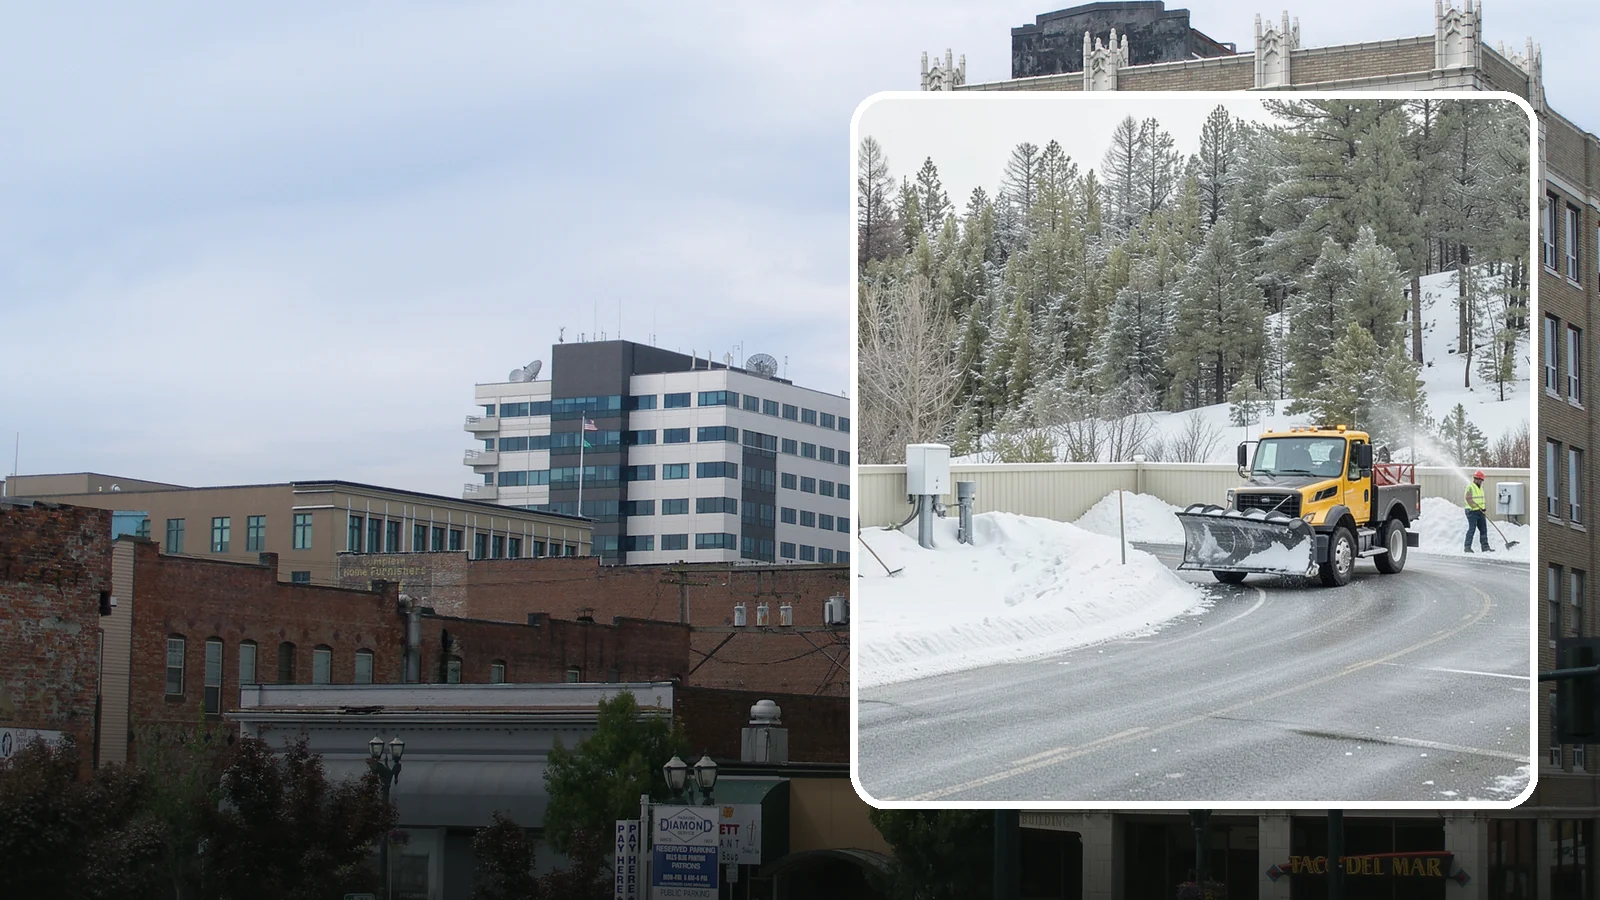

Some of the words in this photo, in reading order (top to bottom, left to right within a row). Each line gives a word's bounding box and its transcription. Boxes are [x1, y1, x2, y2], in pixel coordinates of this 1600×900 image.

[370, 566, 427, 577] Furnishers
[660, 818, 713, 832] DIAMOND
[1022, 815, 1070, 828] BUILDING
[719, 824, 740, 835] ETT
[617, 825, 625, 852] PAY
[628, 824, 637, 852] PAY
[719, 839, 740, 848] ANT
[655, 845, 688, 853] RESERVED
[689, 846, 716, 854] PARKING
[671, 862, 701, 870] PATRONS
[1289, 855, 1329, 874] TAC
[1346, 856, 1385, 876] DEL
[1392, 857, 1442, 877] MAR
[616, 856, 625, 894] HERE
[627, 855, 636, 893] HERE
[660, 889, 682, 897] PUBLIC
[683, 889, 710, 898] PARKING
